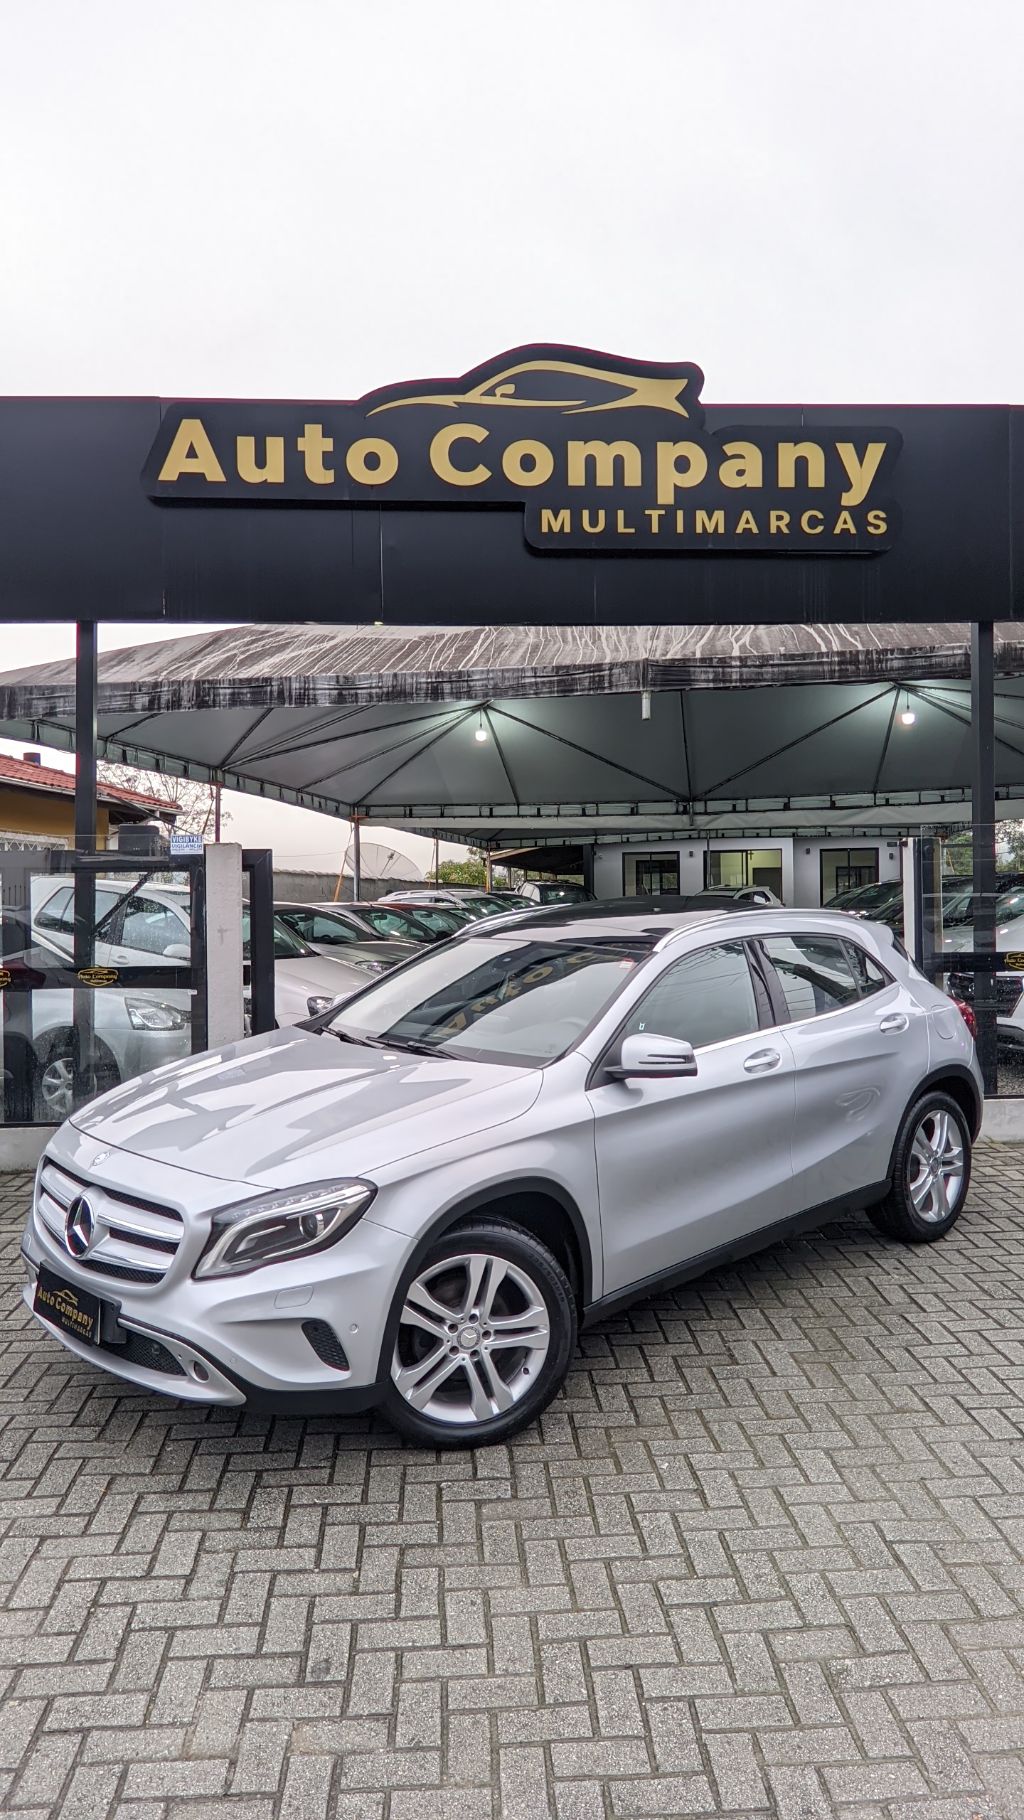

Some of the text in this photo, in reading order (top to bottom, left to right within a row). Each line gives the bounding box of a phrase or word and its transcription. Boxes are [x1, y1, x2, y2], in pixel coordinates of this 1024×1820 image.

[158, 419, 886, 508] Auto Company
[540, 509, 888, 536] MULTIMARCAS
[37, 1286, 94, 1331] Auto Company
